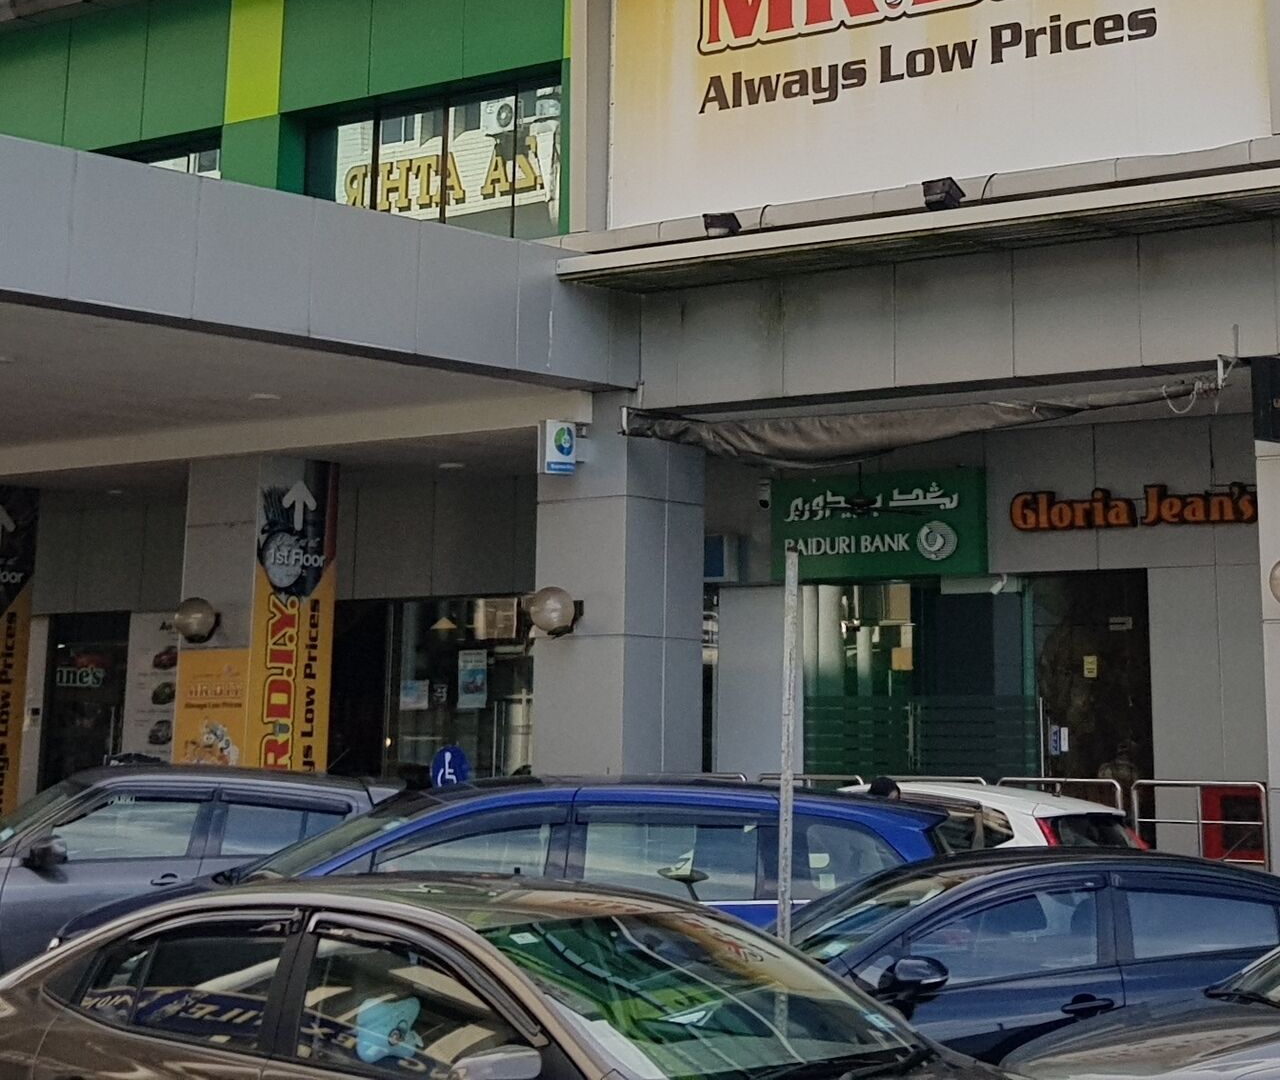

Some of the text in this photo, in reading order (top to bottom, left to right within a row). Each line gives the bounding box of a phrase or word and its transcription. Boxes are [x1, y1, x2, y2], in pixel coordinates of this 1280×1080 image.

[698, 7, 1158, 114] Always Low Prices
[1010, 482, 1258, 531] Gloria Jean's
[291, 549, 326, 568] Floor
[784, 532, 912, 557] BAIDURI BANK
[0, 611, 18, 686] Prices
[303, 598, 322, 681] Prices
[300, 687, 320, 738] Low
